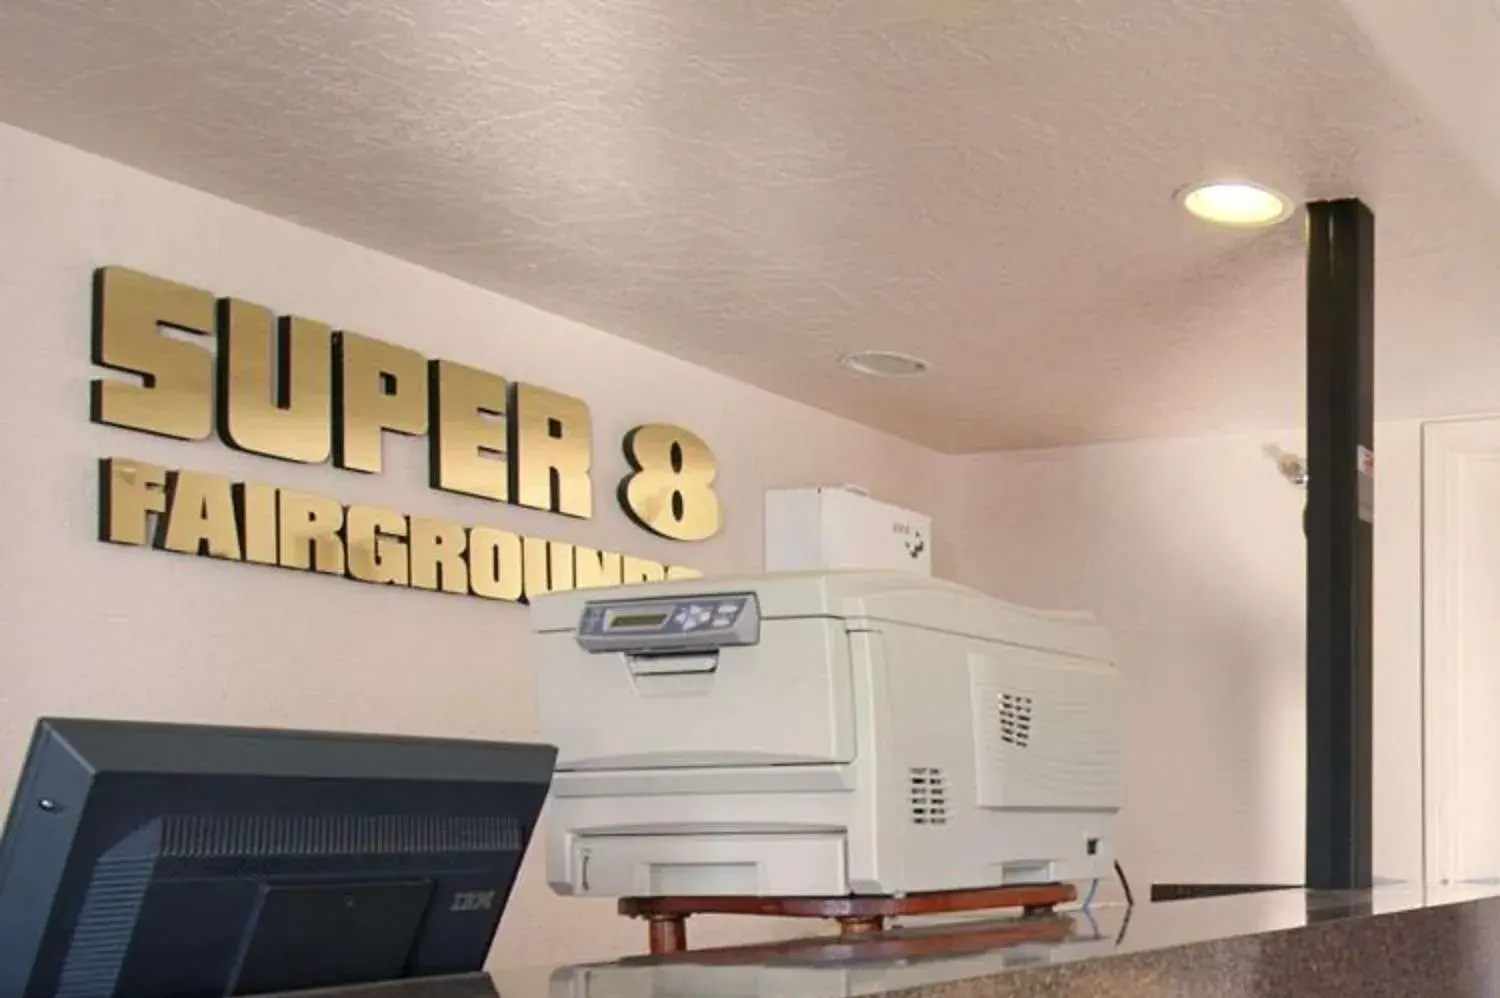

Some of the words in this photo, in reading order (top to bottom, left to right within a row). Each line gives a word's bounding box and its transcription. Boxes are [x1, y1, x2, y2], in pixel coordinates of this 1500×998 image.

[91, 265, 593, 518] SUPER
[617, 422, 724, 542] 8
[98, 457, 704, 605] FAIRGROUN
[449, 890, 496, 911] IBM
